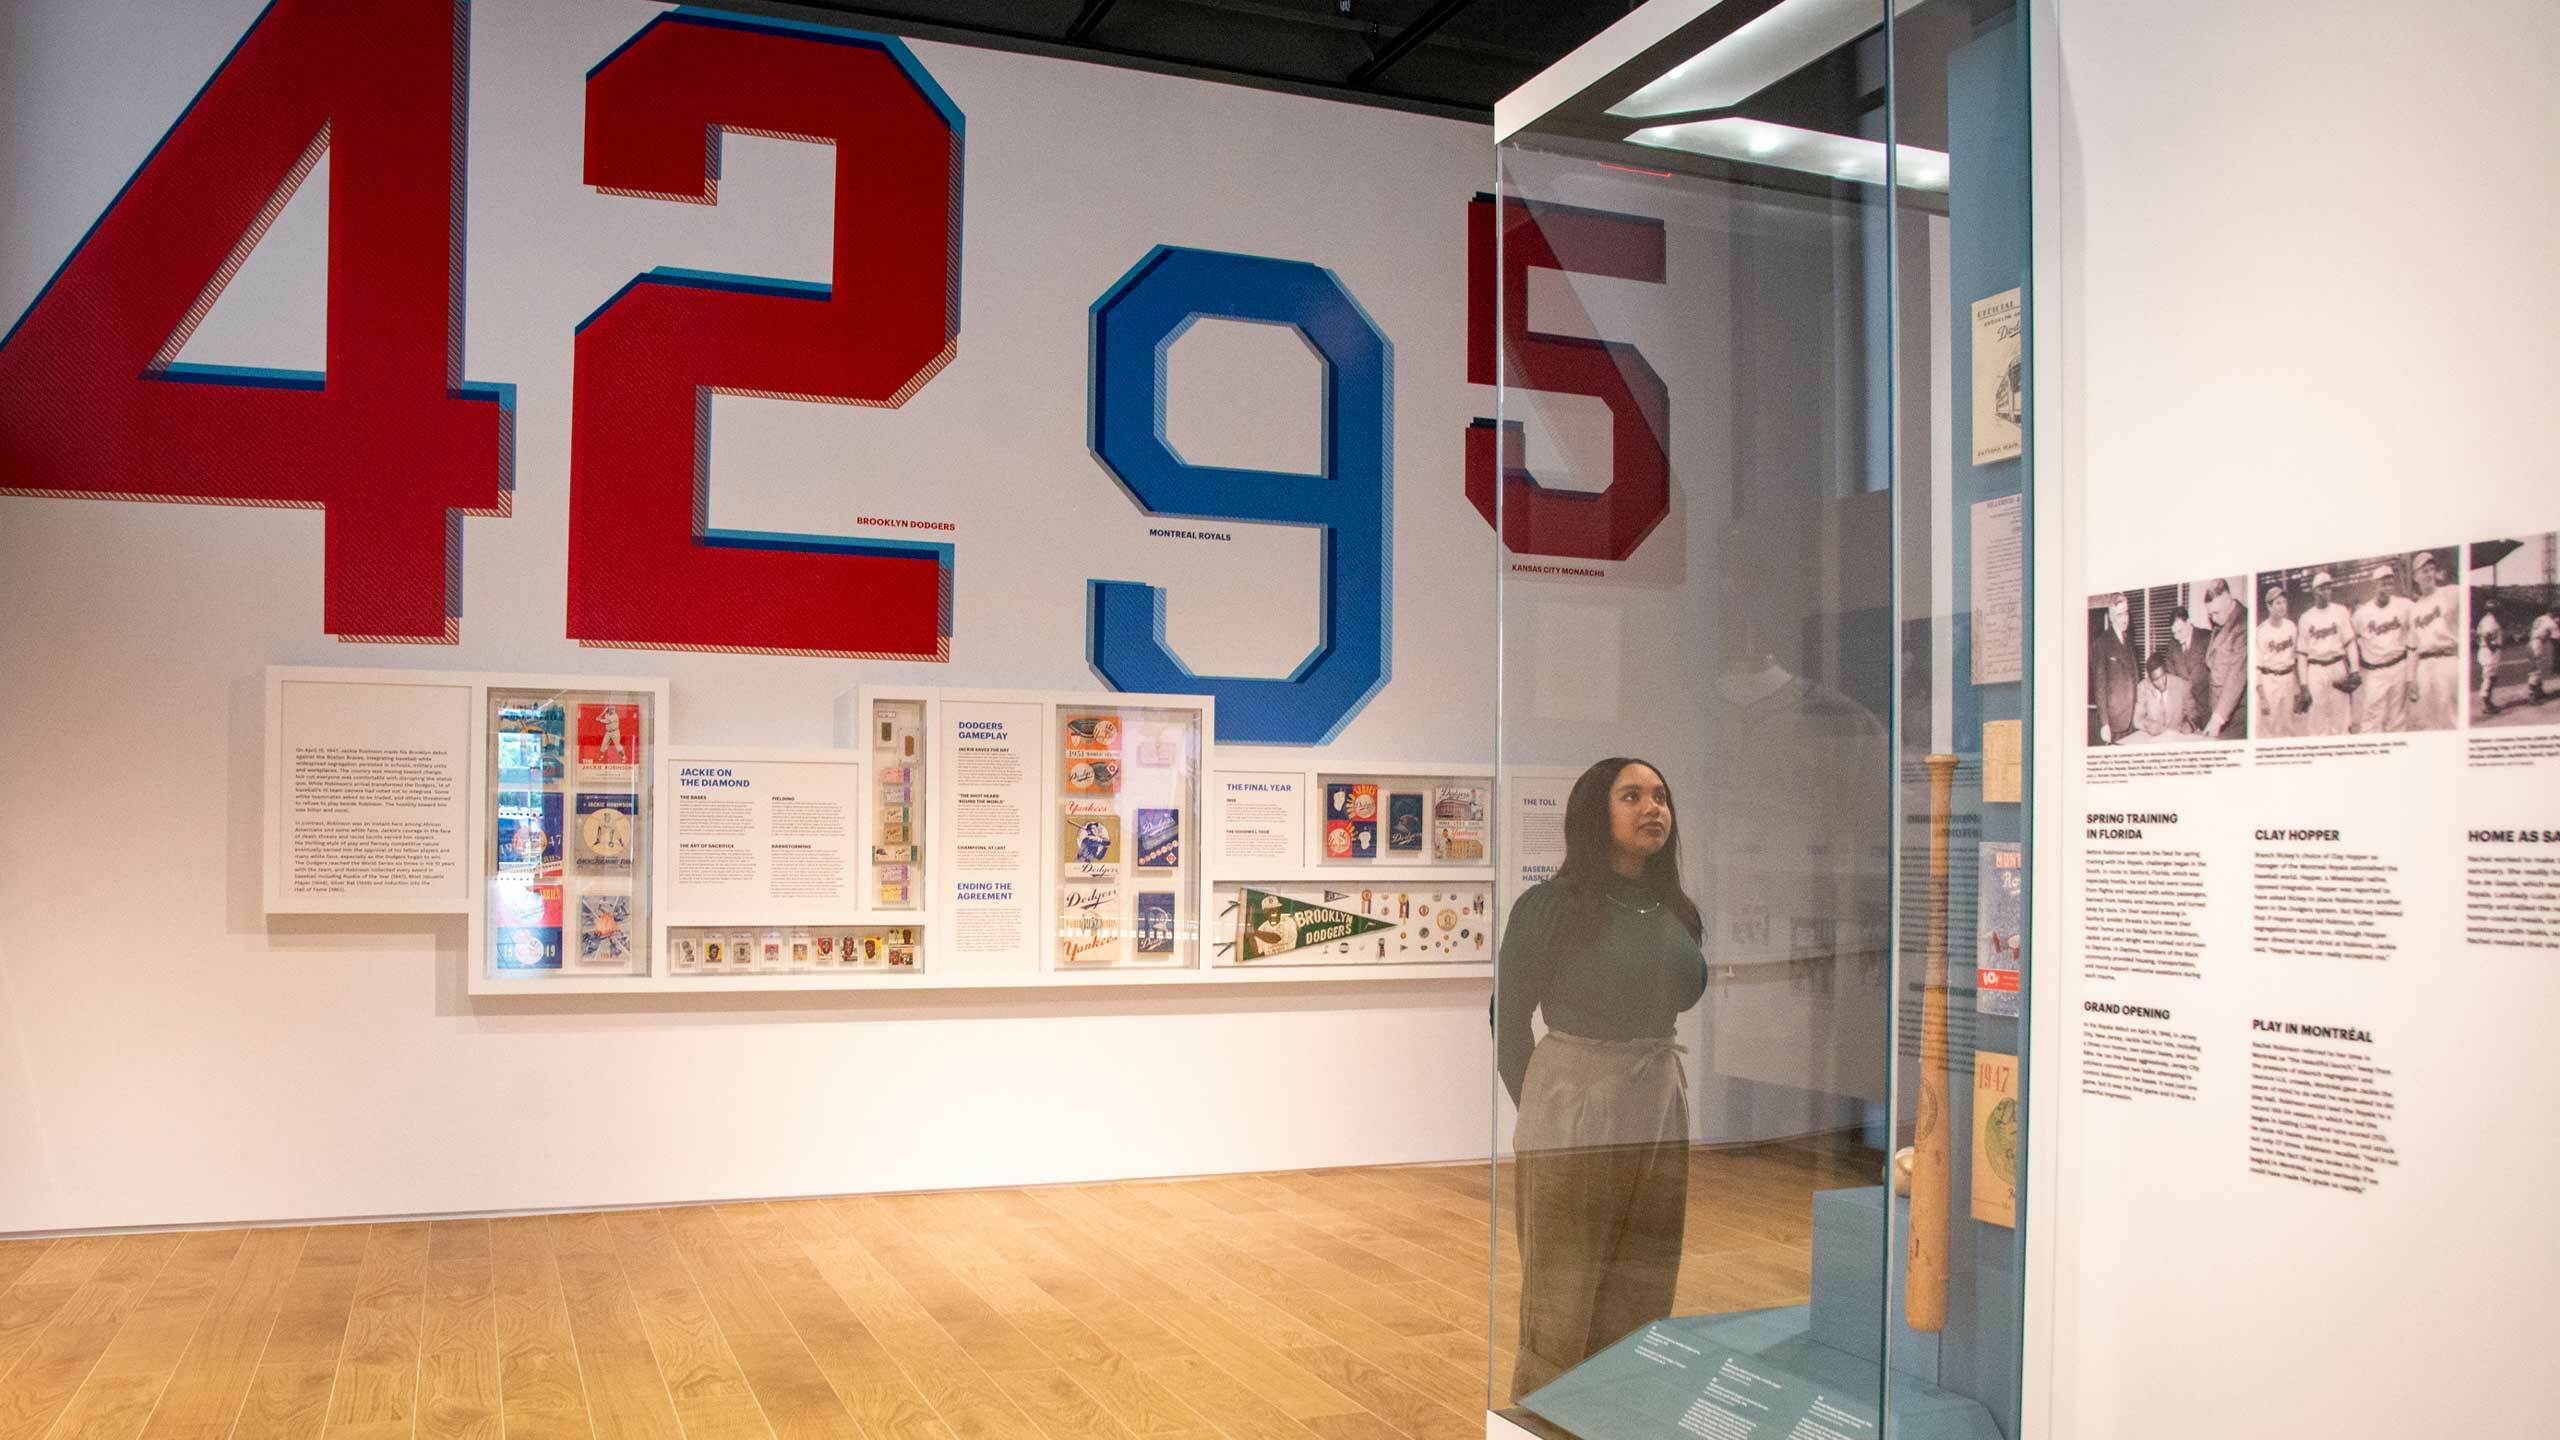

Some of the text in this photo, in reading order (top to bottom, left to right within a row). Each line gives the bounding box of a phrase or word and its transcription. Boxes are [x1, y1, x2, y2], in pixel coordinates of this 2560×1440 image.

[1465, 192, 1670, 561] 5
[857, 517, 955, 531] BROOKLYN DODGERS
[1149, 529, 1231, 541] MONTREAL ROYALS
[1512, 564, 1605, 577] KANSAS CITY MONARCHS
[958, 721, 1003, 730] DODGERS
[958, 731, 1008, 740] GAMEPLAY
[681, 768, 732, 777] JACKIE ON
[681, 779, 750, 788] THE DIAMOND
[1068, 801, 1108, 815] Yankees
[2087, 814, 2178, 824] SPRING TRAINING
[2087, 829, 2143, 840] IN FLORIDA
[2255, 830, 2339, 841] CLAY HOPPER
[2468, 830, 2514, 842] HOME
[2519, 830, 2538, 842] AS
[1081, 864, 1119, 878] Dodgers
[957, 882, 1012, 890] ENDING THE
[957, 892, 1013, 900] AGREEMENT
[1066, 888, 1117, 910] Dodgers
[1294, 908, 1353, 928] BROOKLYN
[1305, 924, 1352, 944] DODGERS
[1064, 934, 1118, 960] Yankees
[2084, 1001, 2170, 1020] GRAND OPENING
[2252, 1019, 2374, 1043] PLAY IN MONTRÉAL
[1979, 1063, 2011, 1092] 1947
